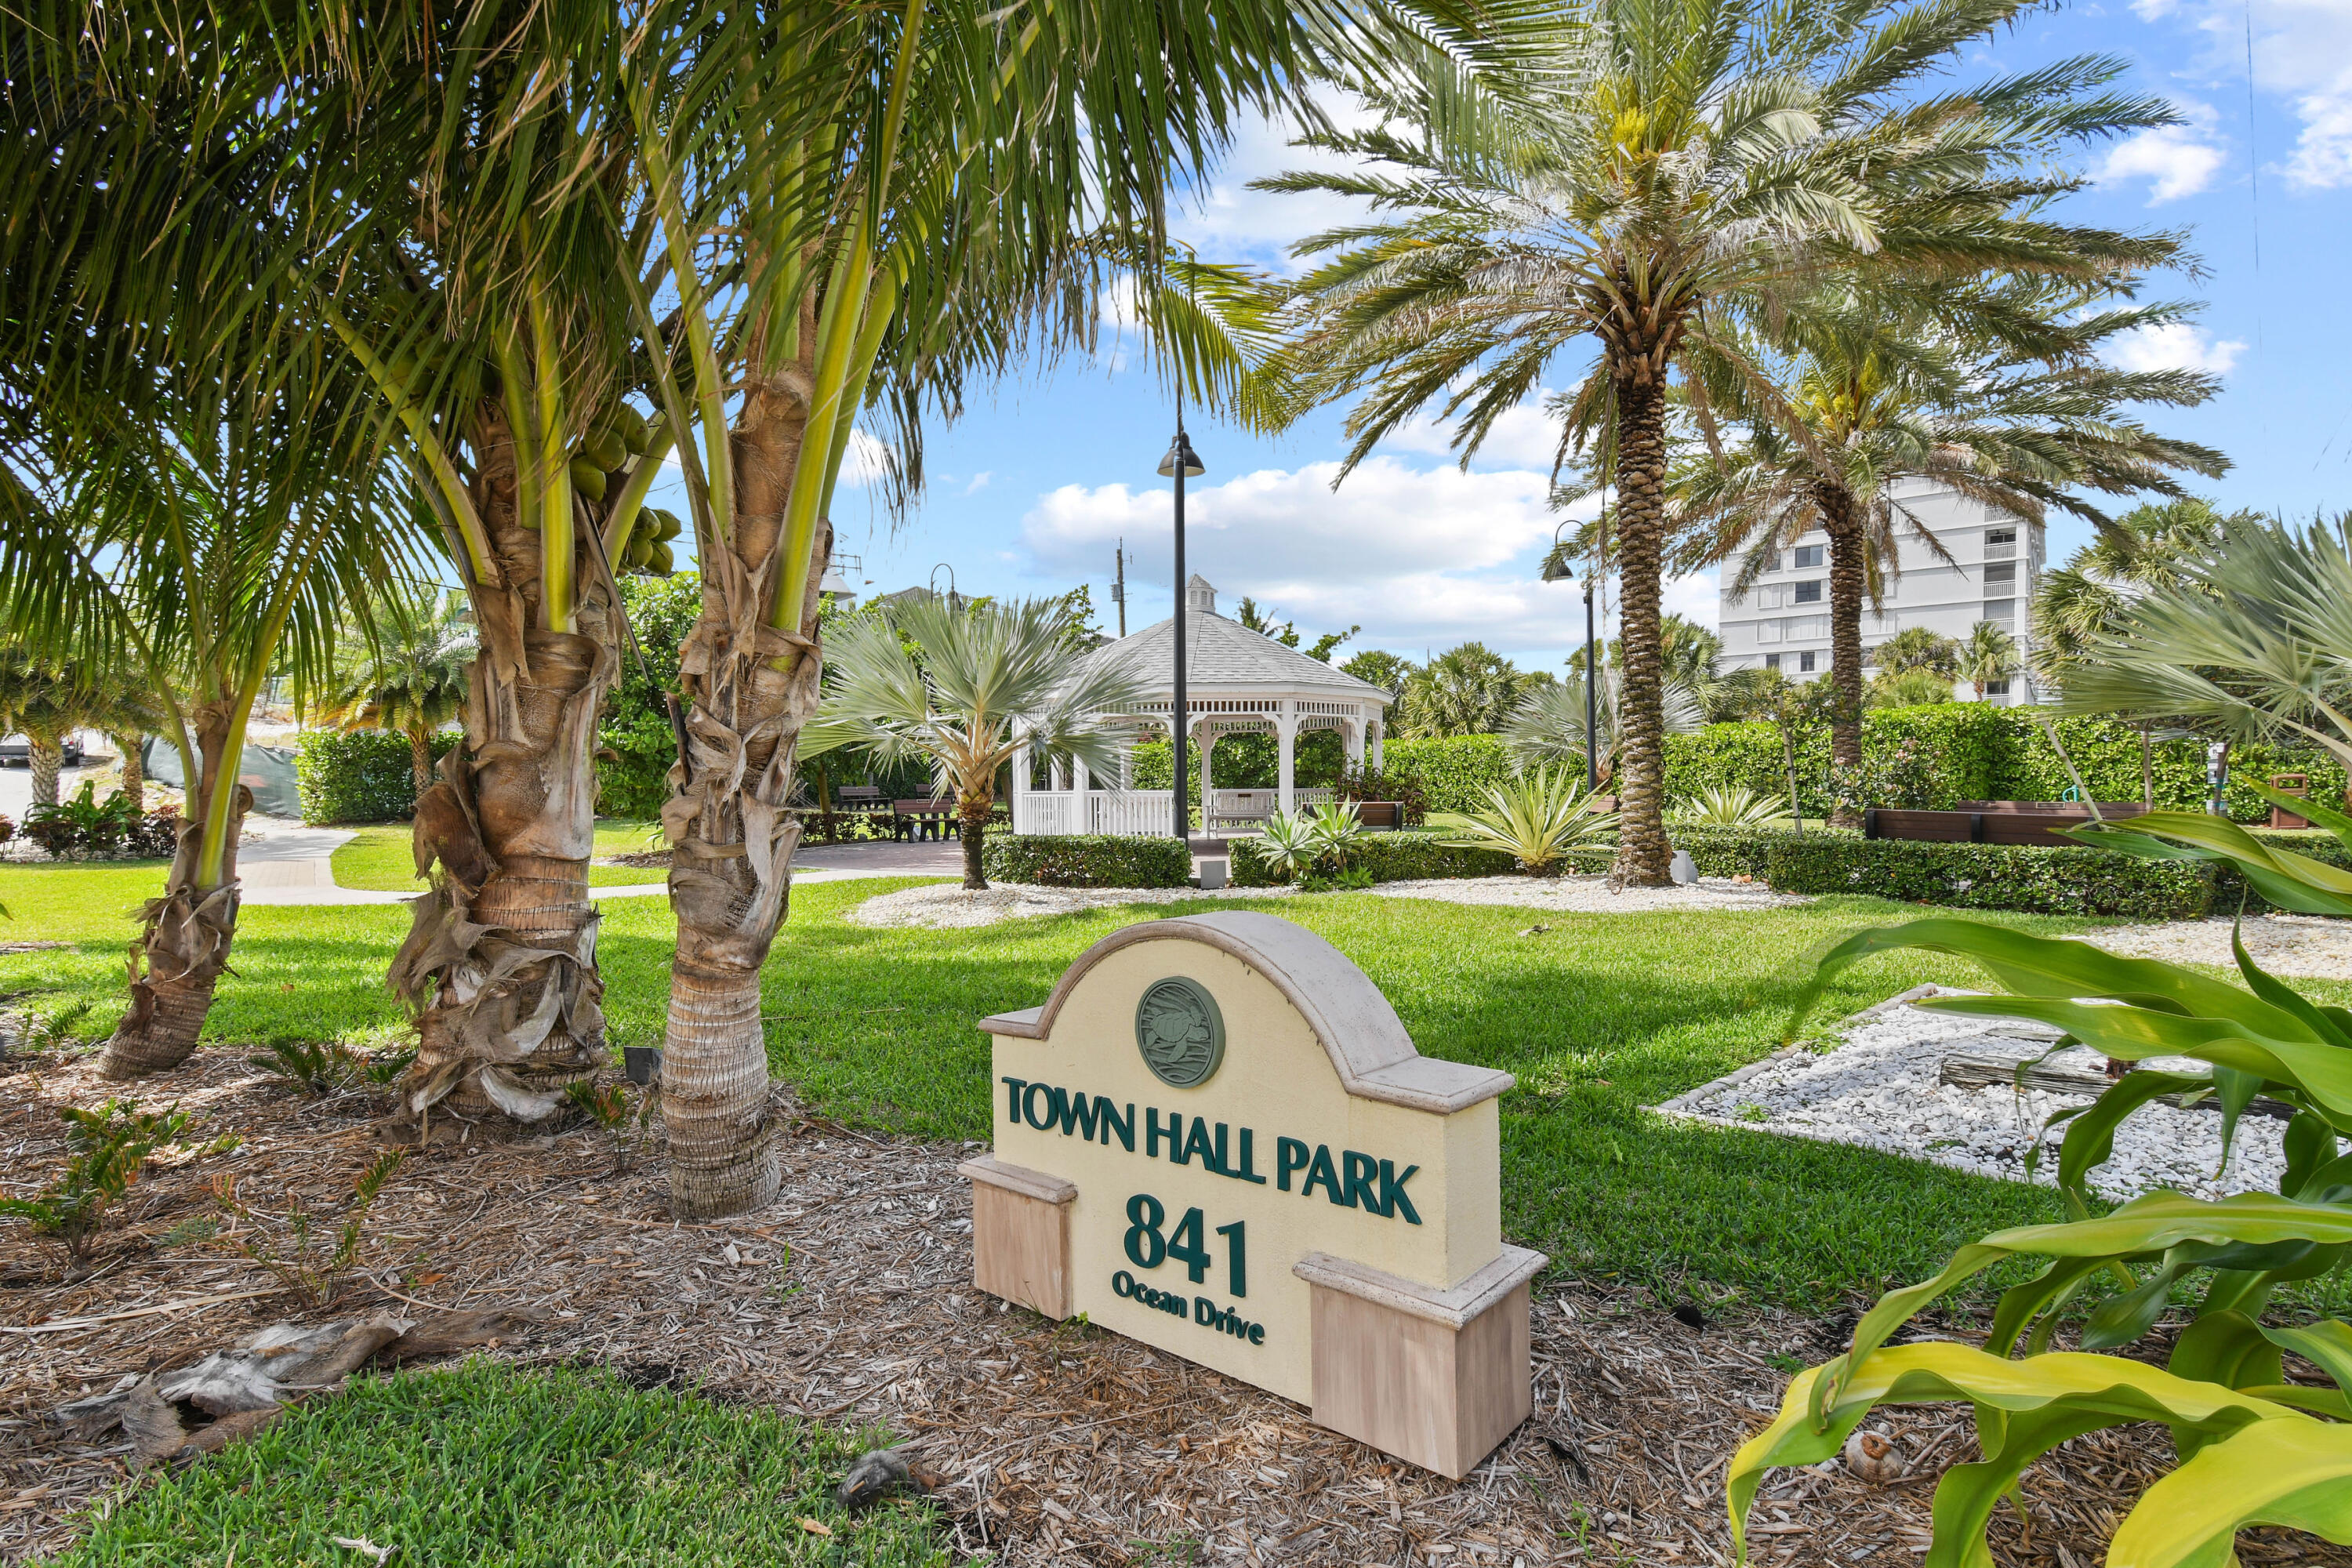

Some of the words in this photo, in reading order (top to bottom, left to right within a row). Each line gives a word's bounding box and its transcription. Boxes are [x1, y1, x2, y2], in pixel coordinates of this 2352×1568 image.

[1001, 1076, 1135, 1152] TOWN
[1146, 1107, 1266, 1185] HALL
[1277, 1136, 1423, 1225] PARK
[1124, 1193, 1246, 1298] 841
[1112, 1270, 1188, 1319] Ocean
[1194, 1296, 1265, 1345] Drive
